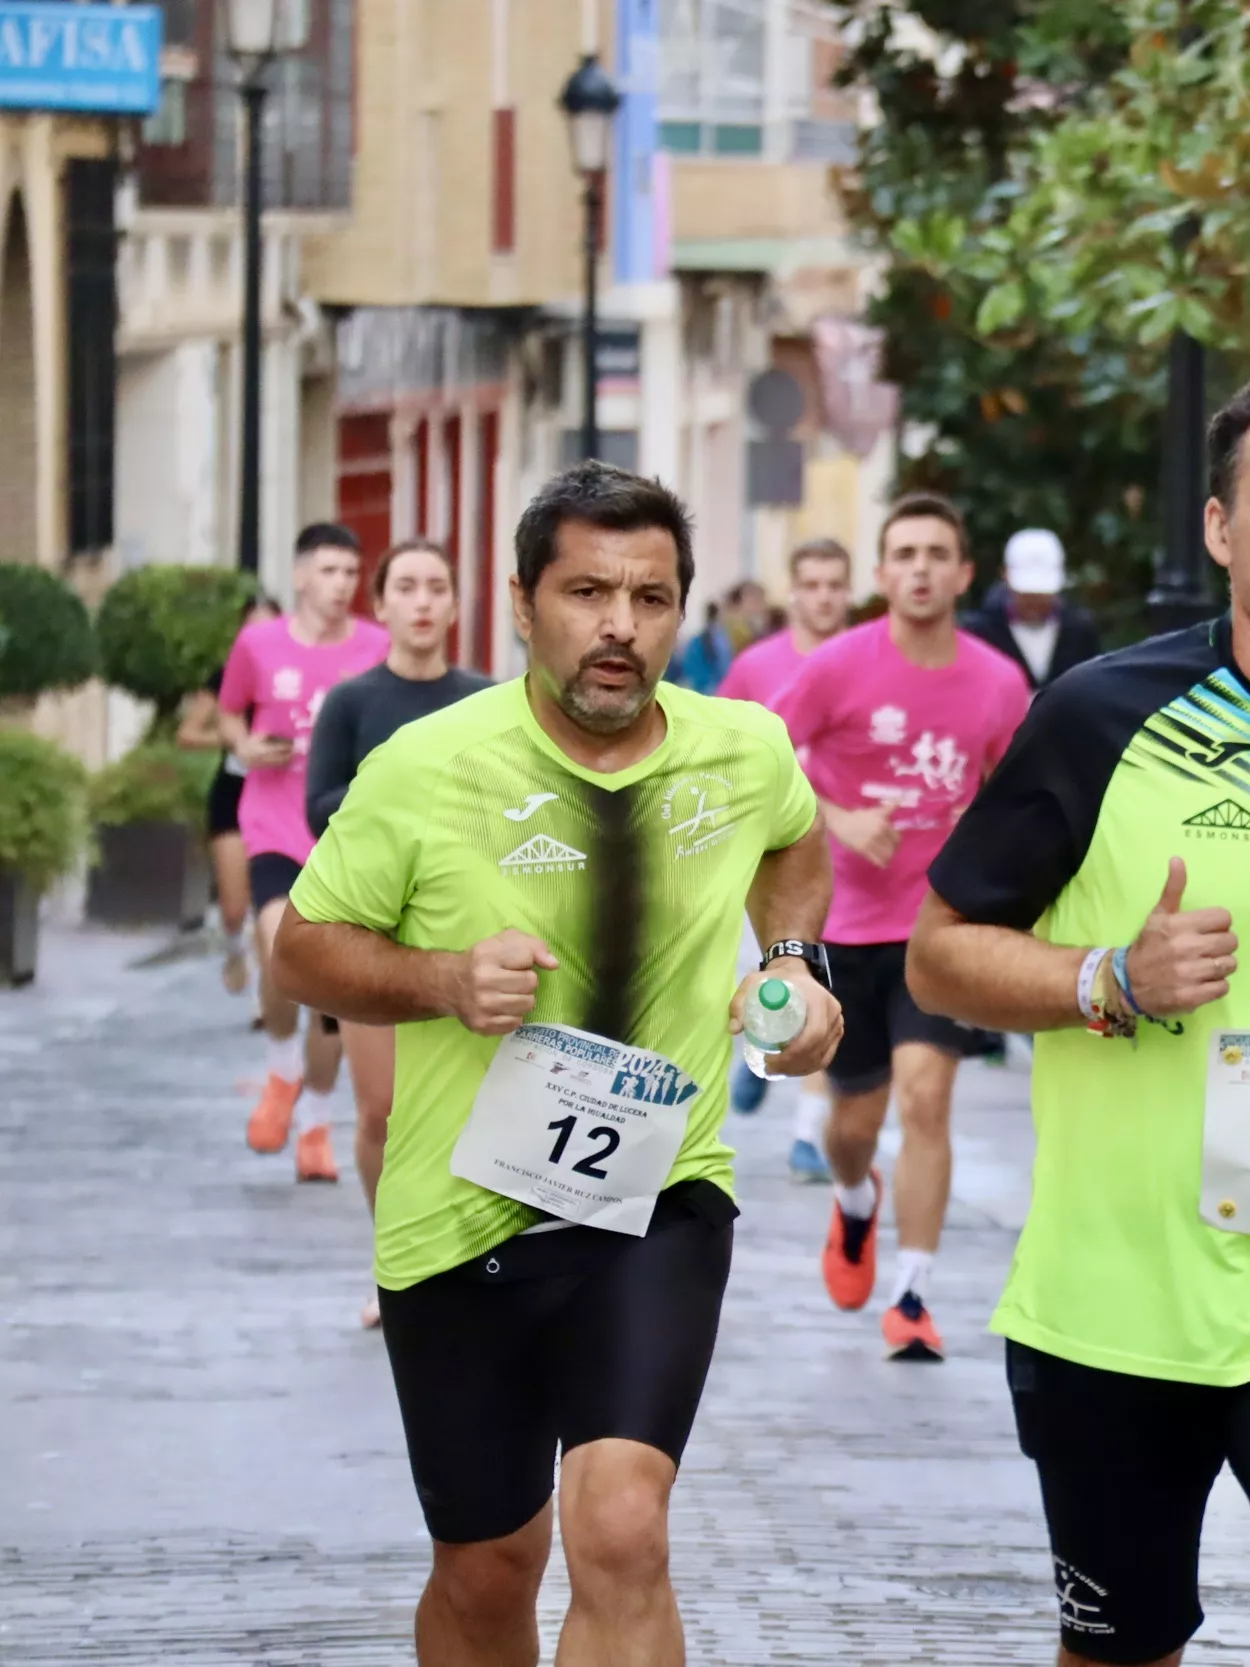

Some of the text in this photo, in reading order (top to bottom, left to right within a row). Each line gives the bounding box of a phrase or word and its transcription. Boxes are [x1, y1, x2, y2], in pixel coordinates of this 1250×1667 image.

[502, 862, 586, 877] ESMONSUR
[558, 1032, 607, 1056] PROVINCIAL
[564, 1044, 618, 1069] POPULARES
[618, 1051, 667, 1079] 2024
[545, 1081, 562, 1095] XXV
[579, 1093, 608, 1108] CIUDAD
[608, 1101, 619, 1111] DE
[558, 1098, 627, 1125] POR LA IGUALDAD
[546, 1115, 621, 1181] 12
[494, 1158, 543, 1181] FRANCISCO
[542, 1176, 573, 1194] JAVIER
